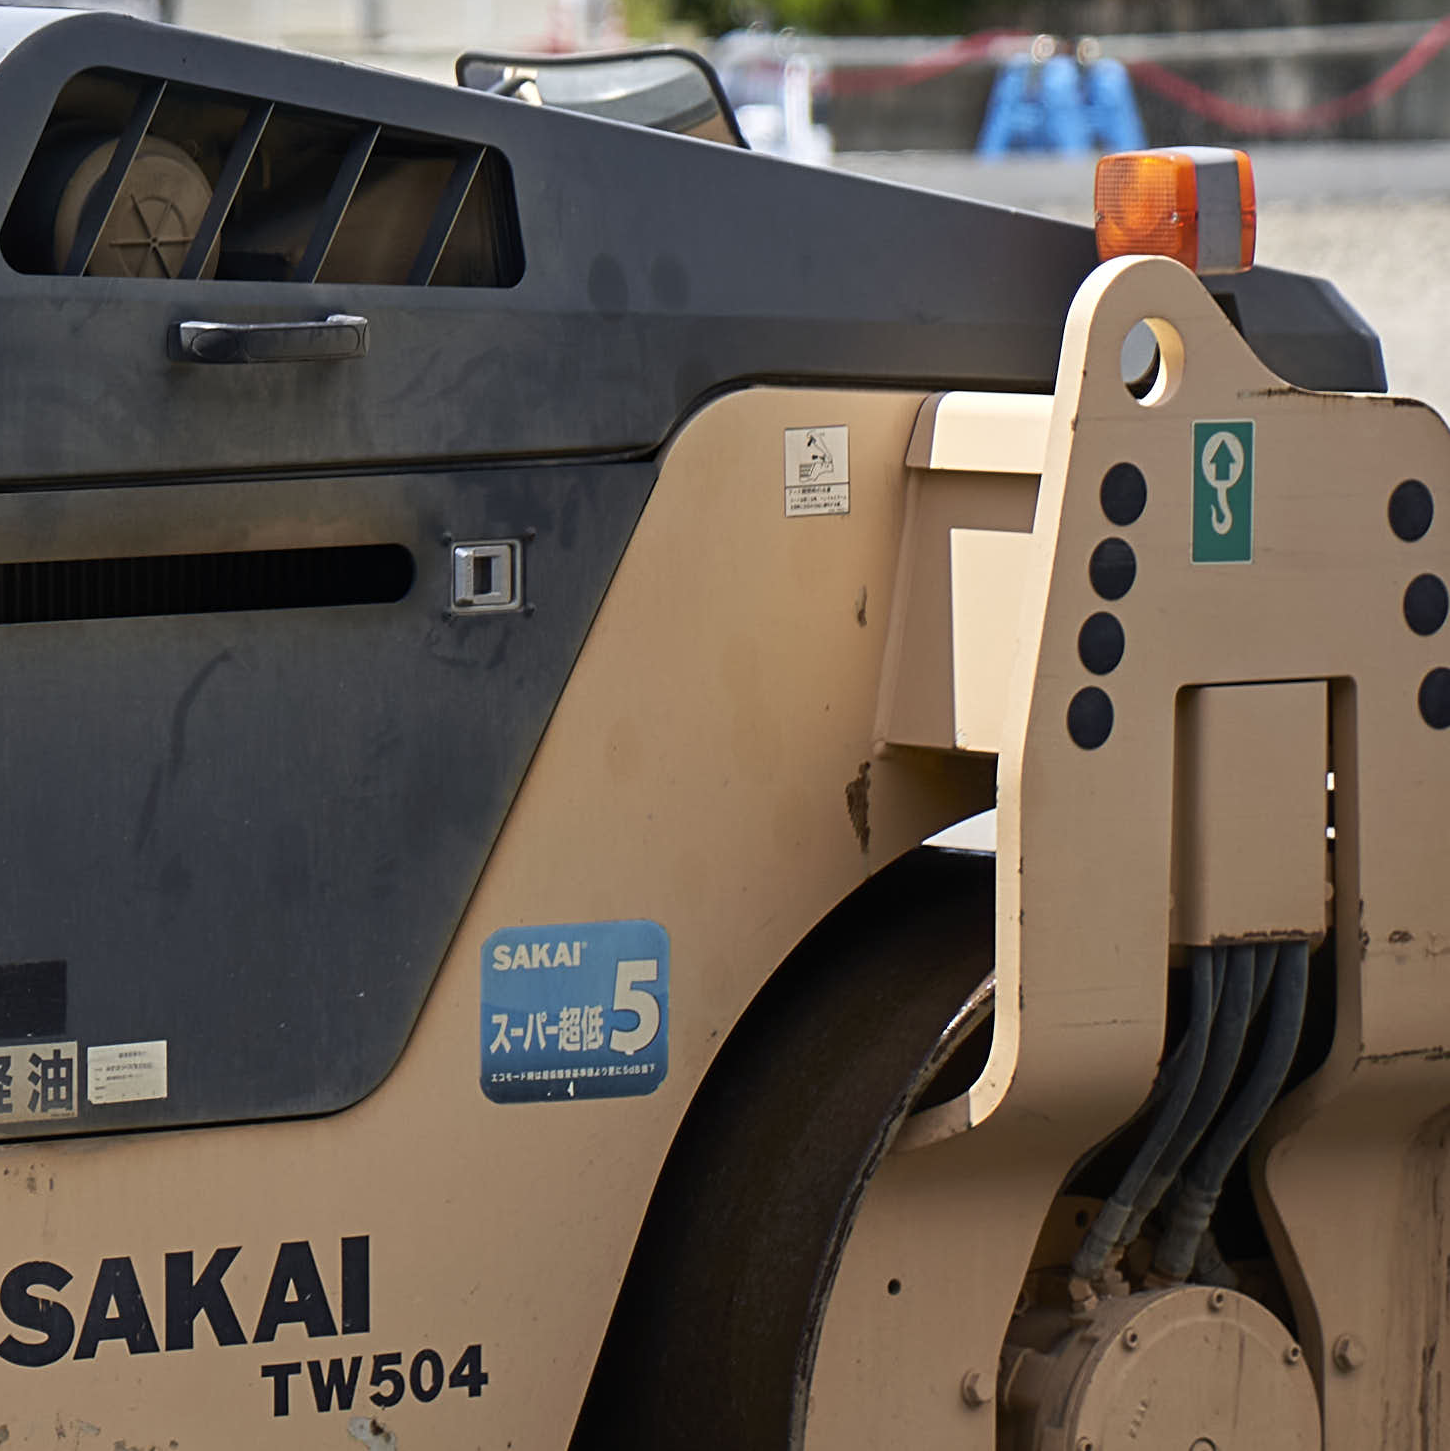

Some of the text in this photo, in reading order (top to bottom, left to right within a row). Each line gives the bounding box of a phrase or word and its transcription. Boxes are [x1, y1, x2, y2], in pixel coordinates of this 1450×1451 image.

[492, 940, 581, 971] SAKAI
[489, 958, 661, 1056] スーパー超低 5
[260, 1343, 489, 1418] TW504
